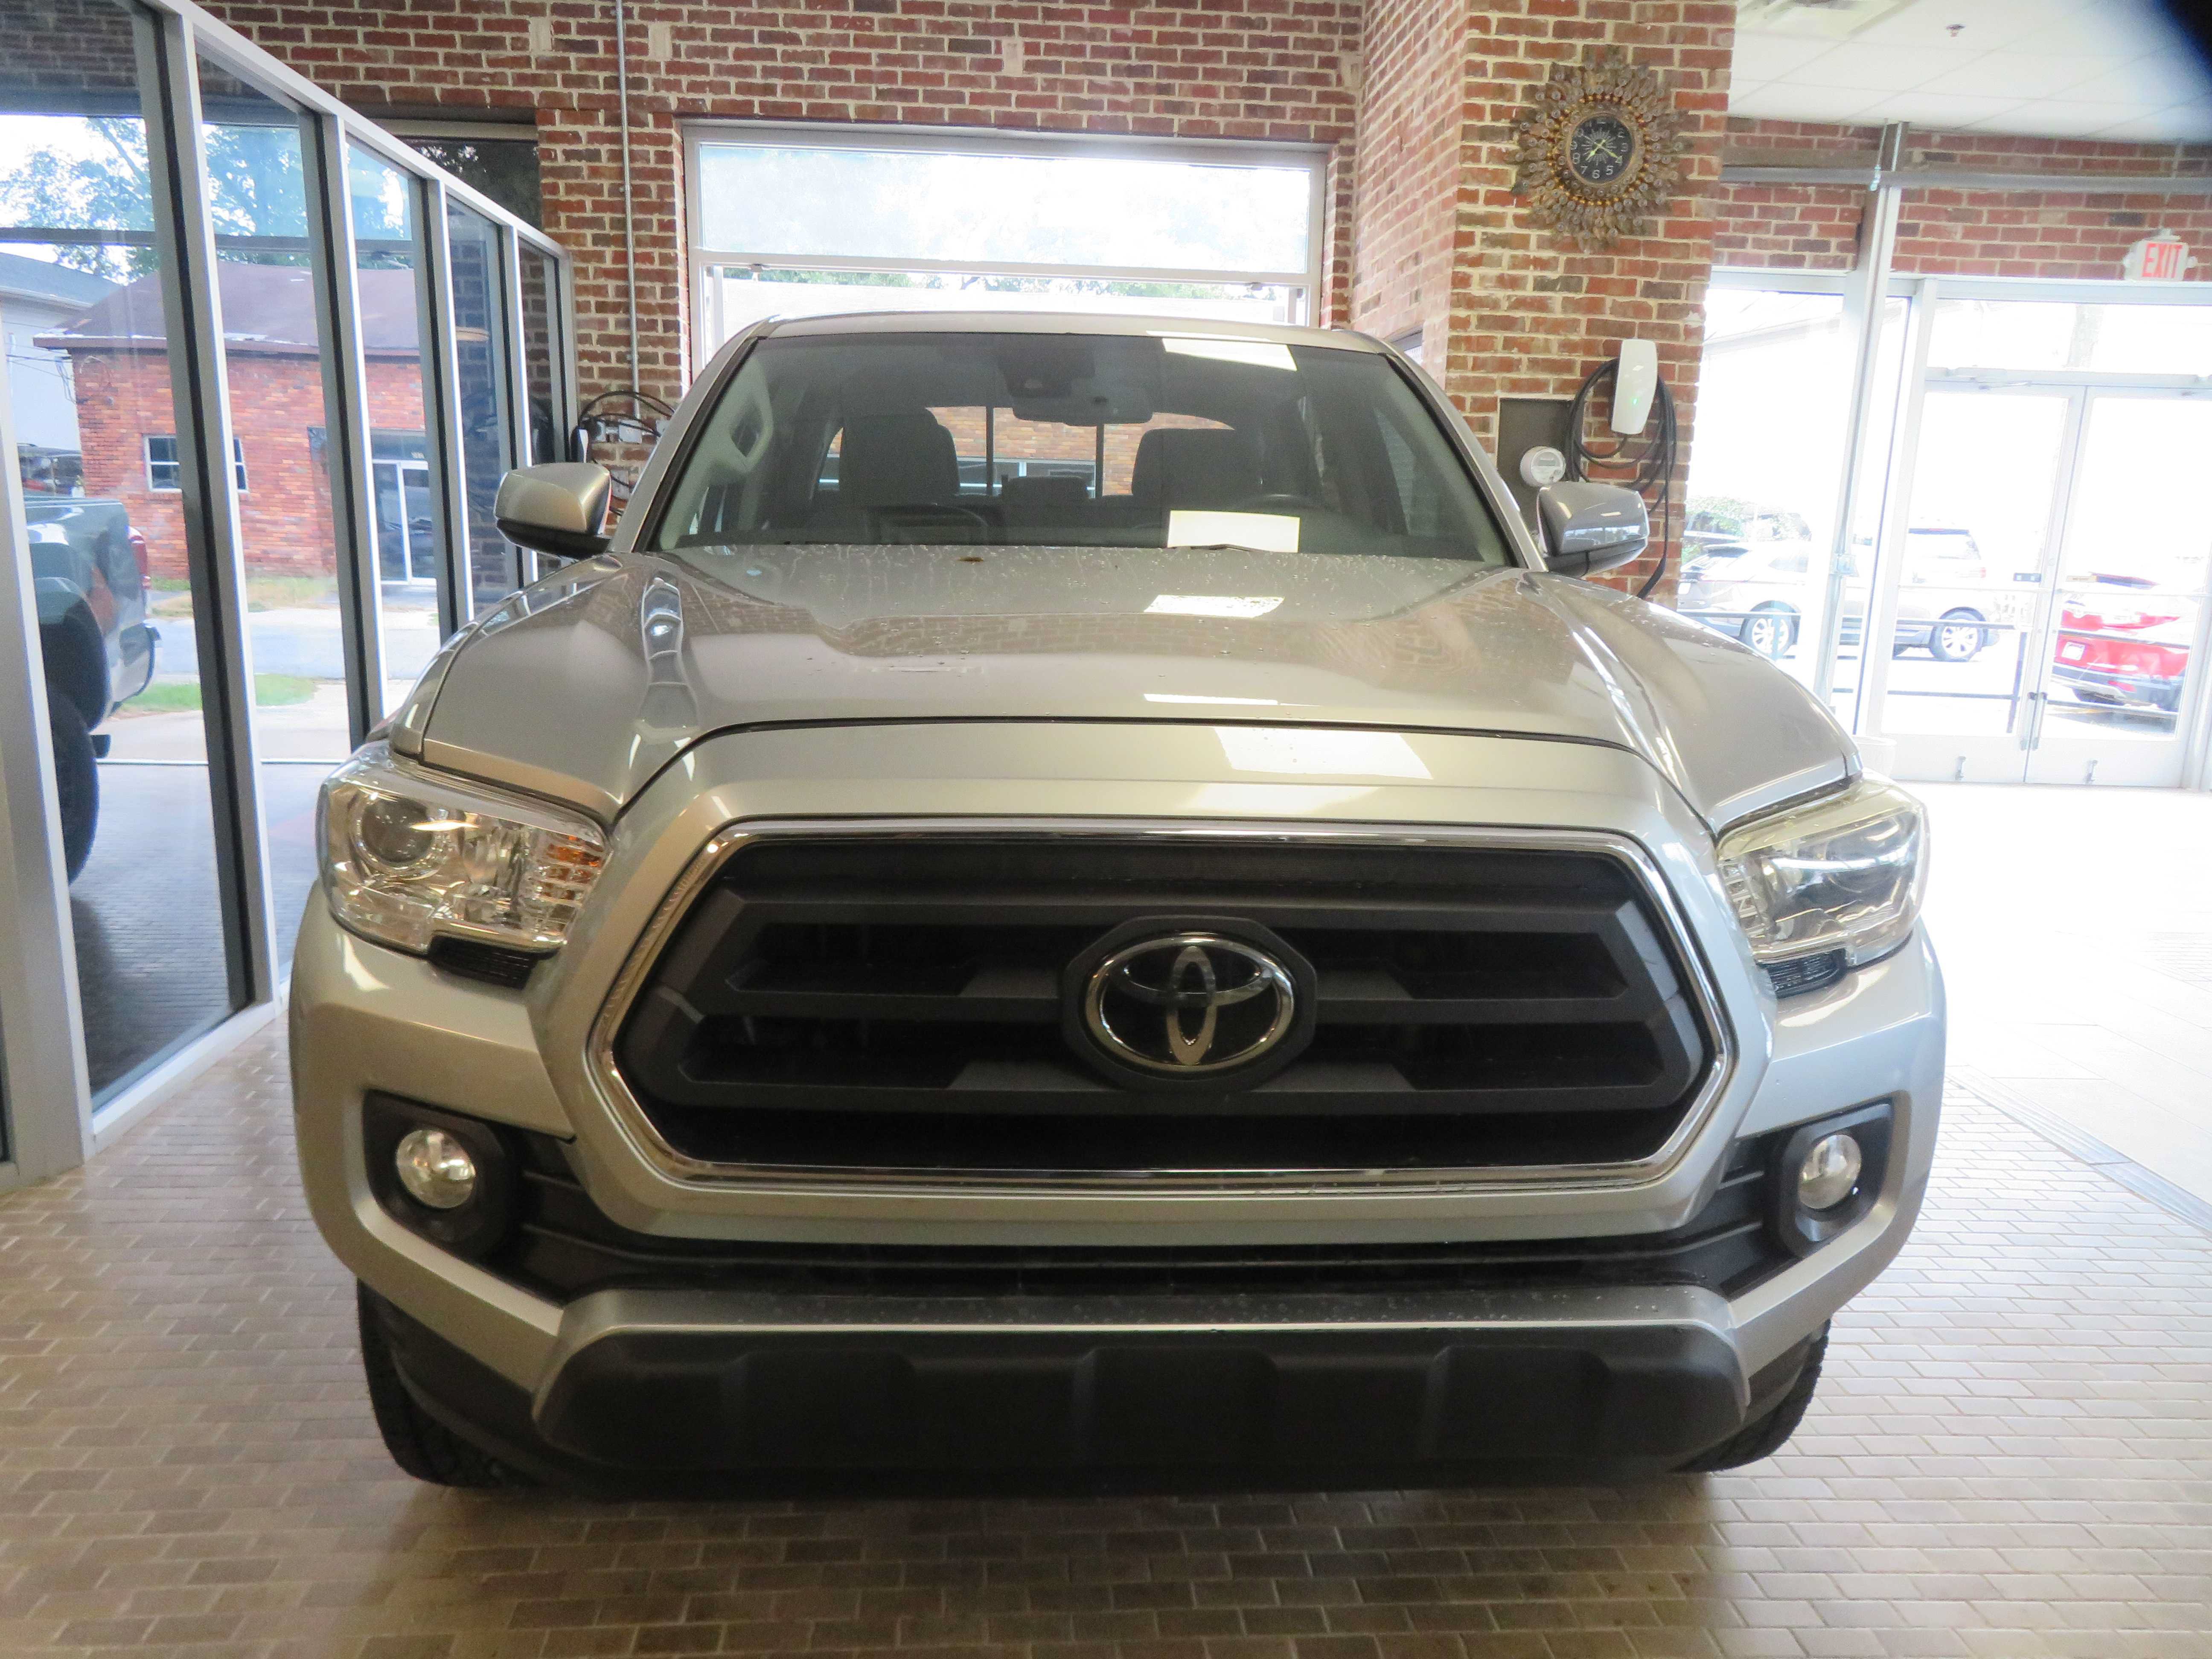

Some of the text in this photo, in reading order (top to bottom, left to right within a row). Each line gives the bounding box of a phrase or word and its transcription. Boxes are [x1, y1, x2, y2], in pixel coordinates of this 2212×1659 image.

[1621, 143, 1628, 152] 3
[1573, 152, 1580, 164] 8
[1580, 165, 1588, 174] 7
[1592, 169, 1600, 178] 6
[1606, 165, 1613, 175] 5
[2142, 243, 2183, 278] EXIT
